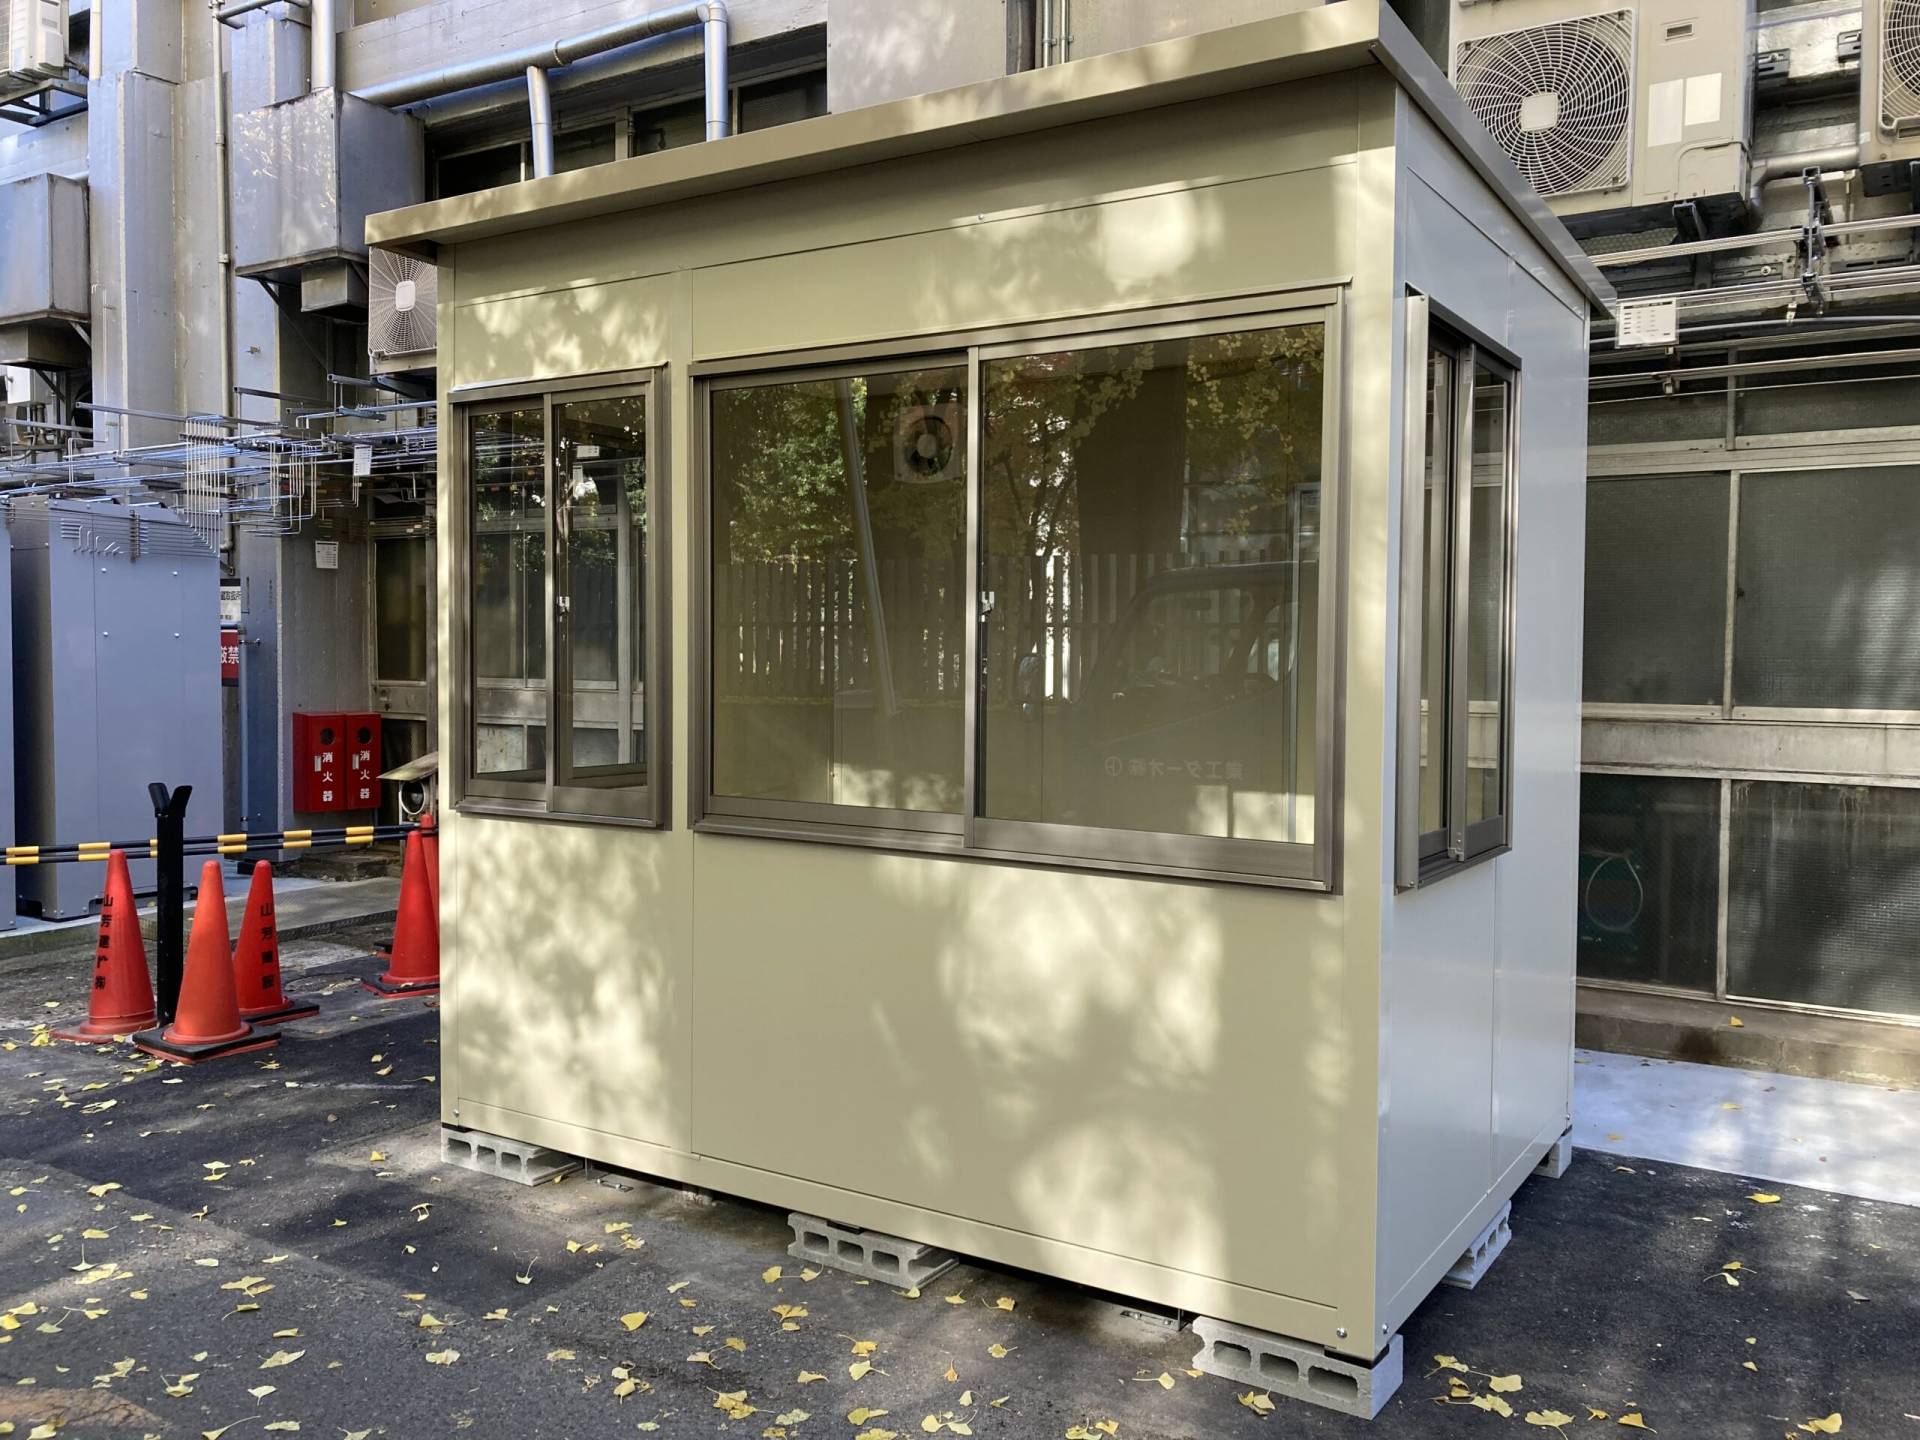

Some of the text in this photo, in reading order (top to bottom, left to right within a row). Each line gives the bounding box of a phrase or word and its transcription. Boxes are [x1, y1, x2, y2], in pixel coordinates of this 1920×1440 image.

[322, 751, 334, 802] 消火器
[359, 750, 371, 799] 消火器
